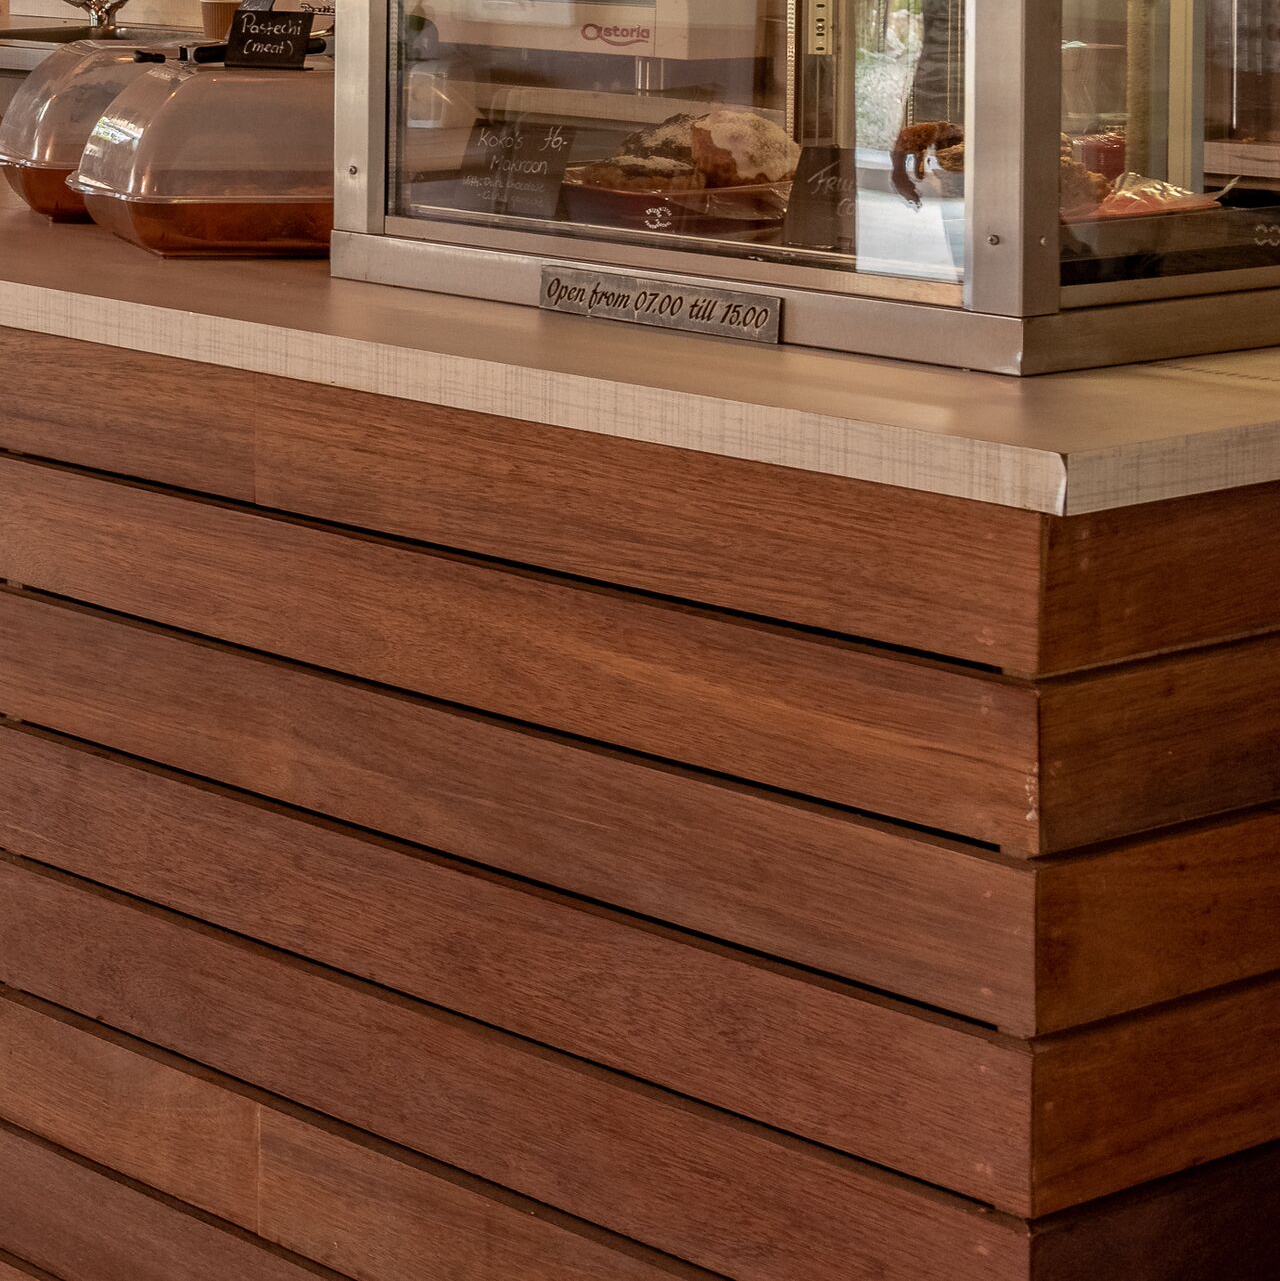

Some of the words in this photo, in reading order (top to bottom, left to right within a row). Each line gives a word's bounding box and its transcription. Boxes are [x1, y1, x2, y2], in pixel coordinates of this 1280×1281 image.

[241, 12, 303, 36] Pastechi
[243, 39, 294, 56] (meat)
[489, 154, 549, 175] Makroon
[546, 277, 586, 306] Open
[588, 282, 631, 310] from
[634, 290, 684, 317] 07.00
[689, 297, 718, 322] till
[720, 303, 769, 330] 15.00
